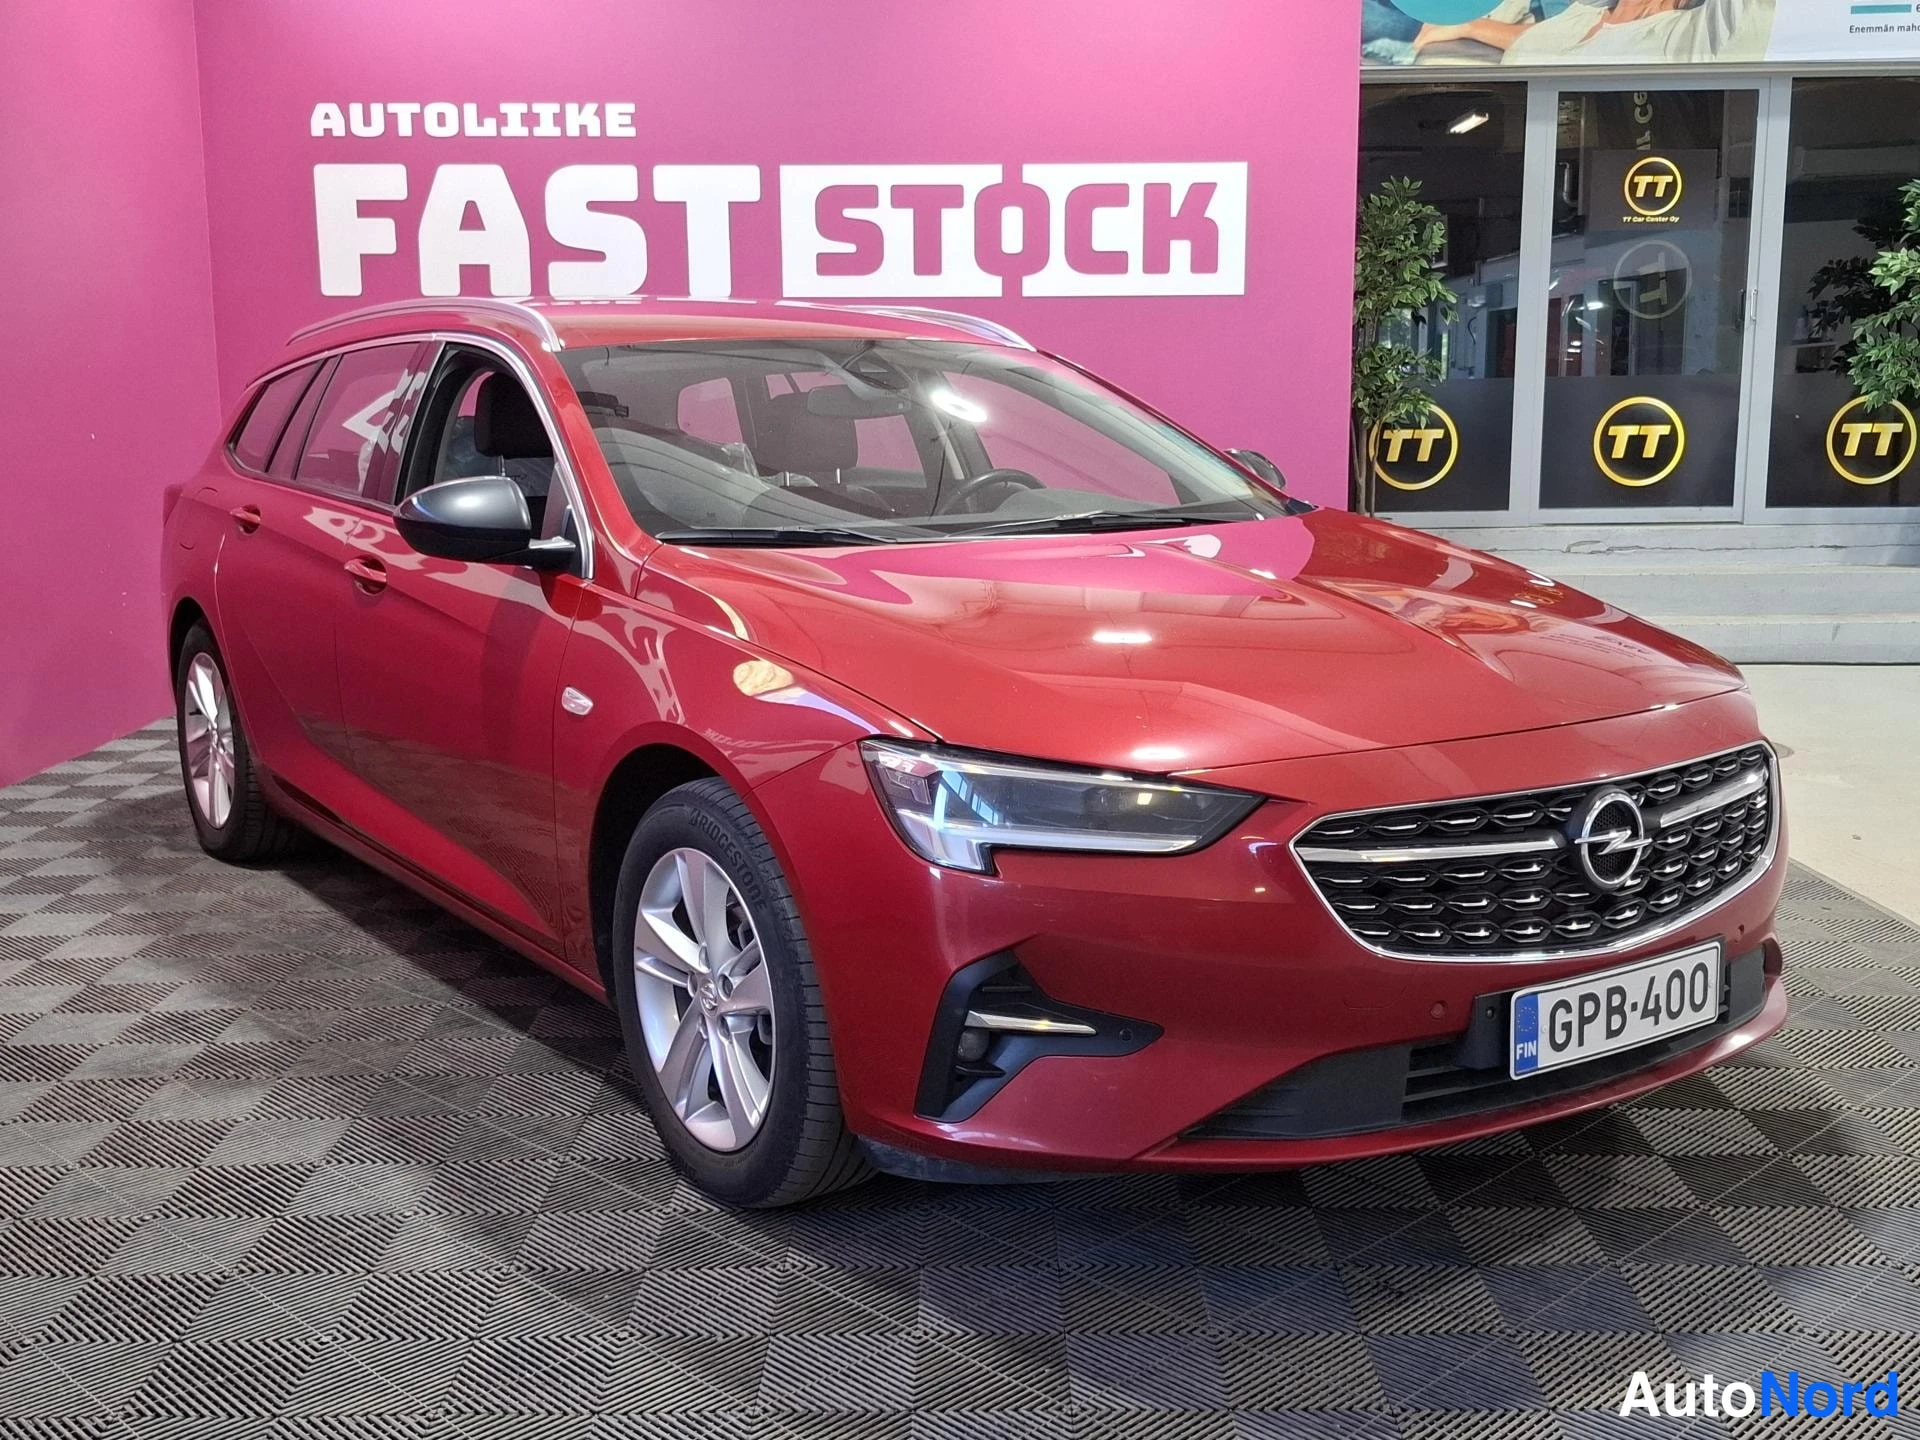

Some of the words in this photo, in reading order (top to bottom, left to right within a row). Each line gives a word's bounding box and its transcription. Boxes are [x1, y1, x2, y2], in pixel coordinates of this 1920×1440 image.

[1849, 24, 1895, 33] Enemmän
[311, 102, 637, 137] AUTOLIIKE
[1633, 175, 1674, 198] TT
[313, 163, 761, 297] FAST
[815, 182, 1219, 277] STOCK
[1669, 215, 1680, 223] Oy
[1382, 428, 1445, 463] TT
[1607, 425, 1671, 459] TT
[1841, 423, 1904, 456] TT
[688, 807, 768, 914] BRIDGESTONE
[1549, 961, 1709, 1053] GPB-400
[1516, 1040, 1537, 1061] FIN
